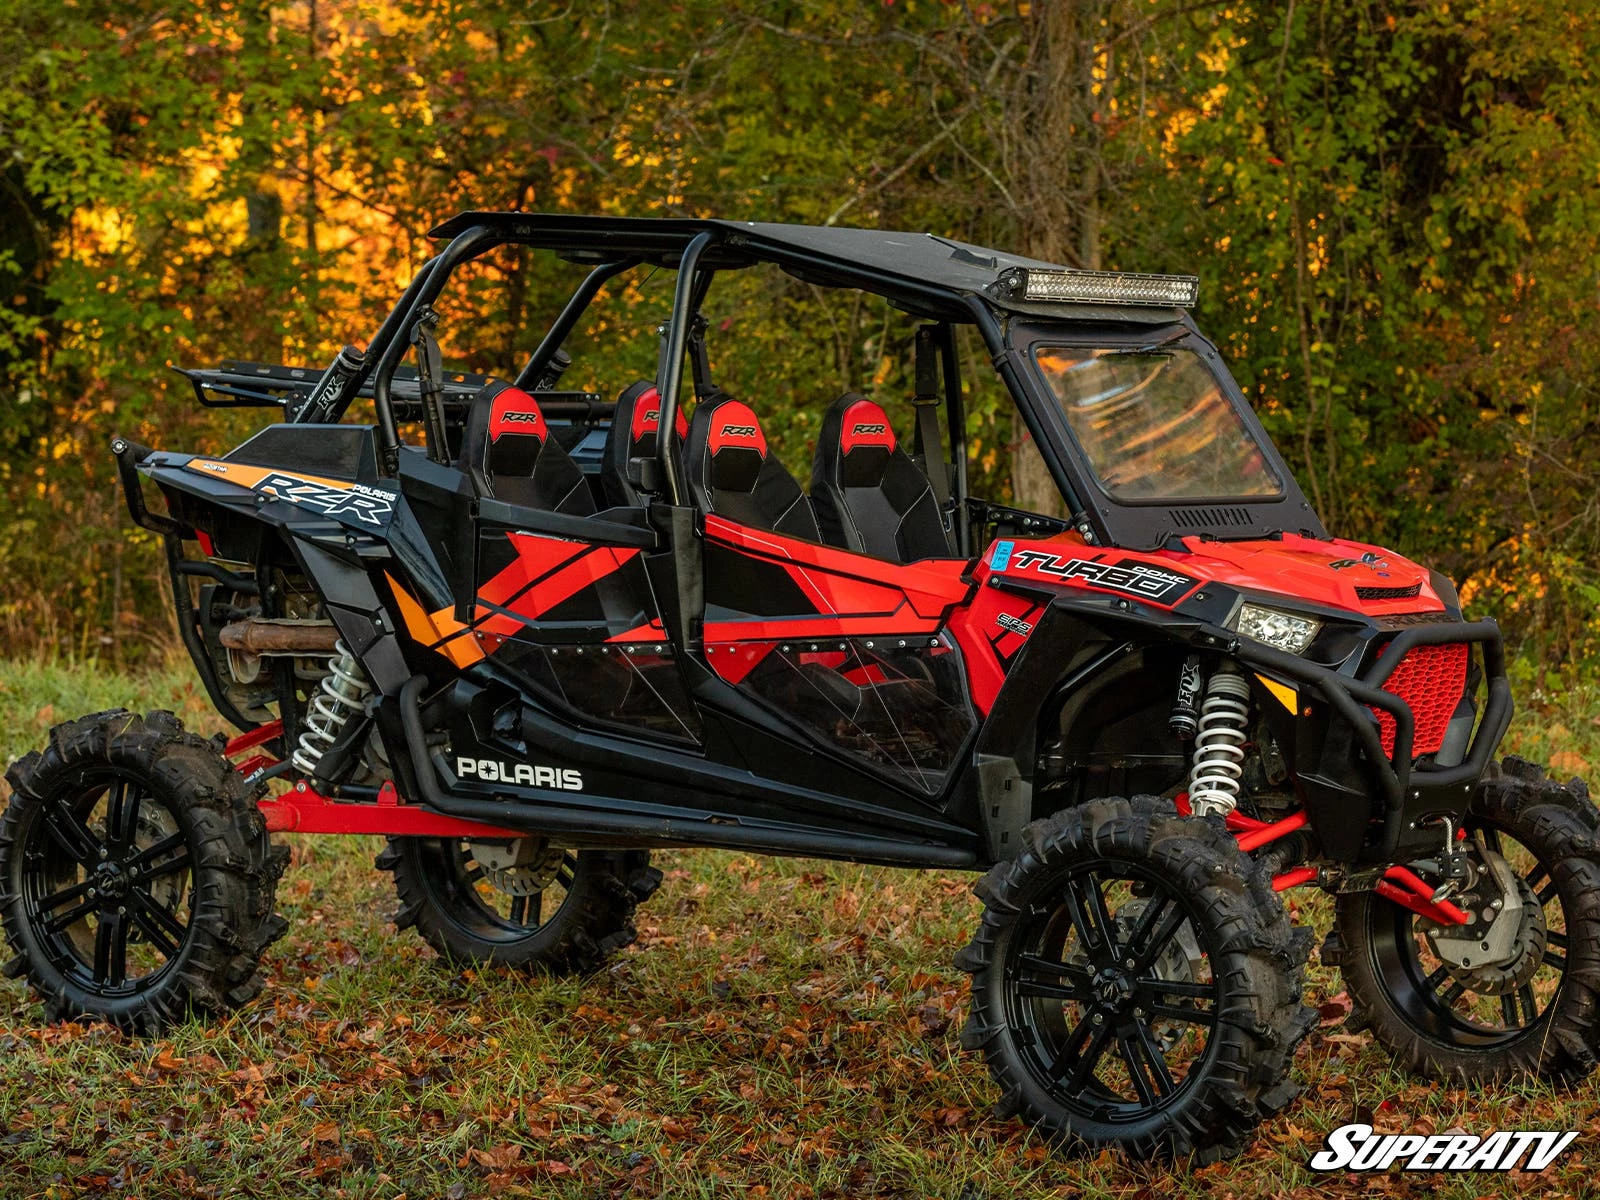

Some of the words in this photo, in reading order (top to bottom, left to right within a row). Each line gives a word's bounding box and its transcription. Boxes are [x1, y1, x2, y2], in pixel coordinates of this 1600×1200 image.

[316, 376, 344, 409] FOX
[501, 410, 537, 423] RZR
[720, 423, 756, 437] RZR
[852, 423, 886, 435] RZR
[250, 472, 393, 525] RZR
[351, 484, 397, 501] POLARIS
[1012, 550, 1178, 598] TURBO
[1131, 565, 1190, 585] DOHC
[997, 612, 1033, 632] EPS
[1178, 663, 1199, 705] FOX
[457, 756, 583, 791] POLARIS
